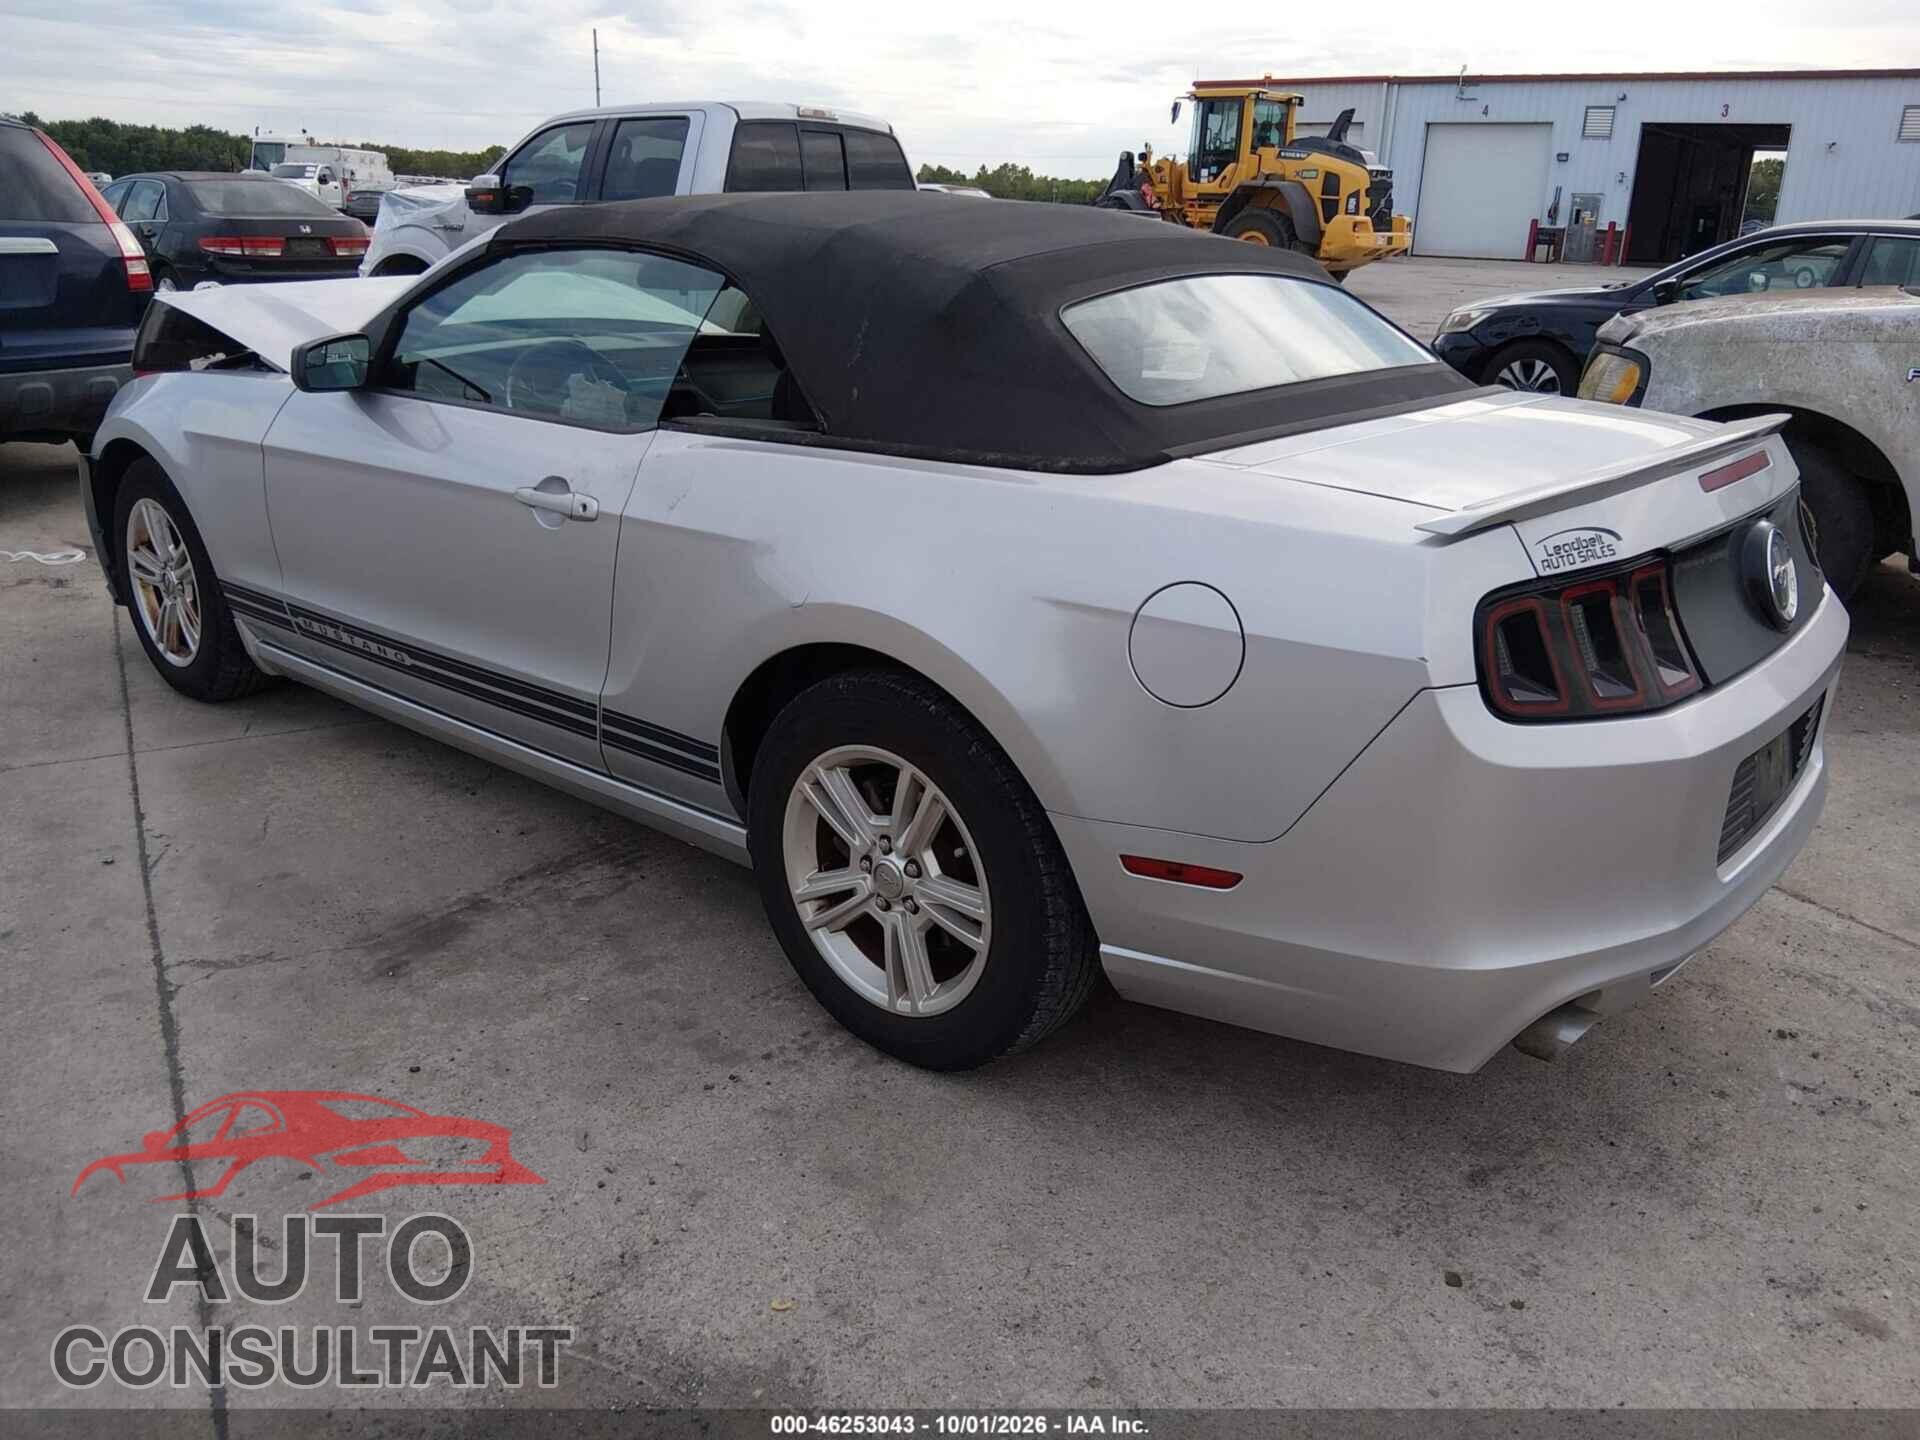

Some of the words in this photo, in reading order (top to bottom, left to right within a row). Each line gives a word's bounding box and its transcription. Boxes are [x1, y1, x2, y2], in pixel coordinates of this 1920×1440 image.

[1481, 105, 1489, 117] 4
[1721, 103, 1730, 118] 3
[1541, 553, 1576, 571] AUTO
[1577, 544, 1616, 563] SALES
[302, 619, 405, 662] MUSTANG
